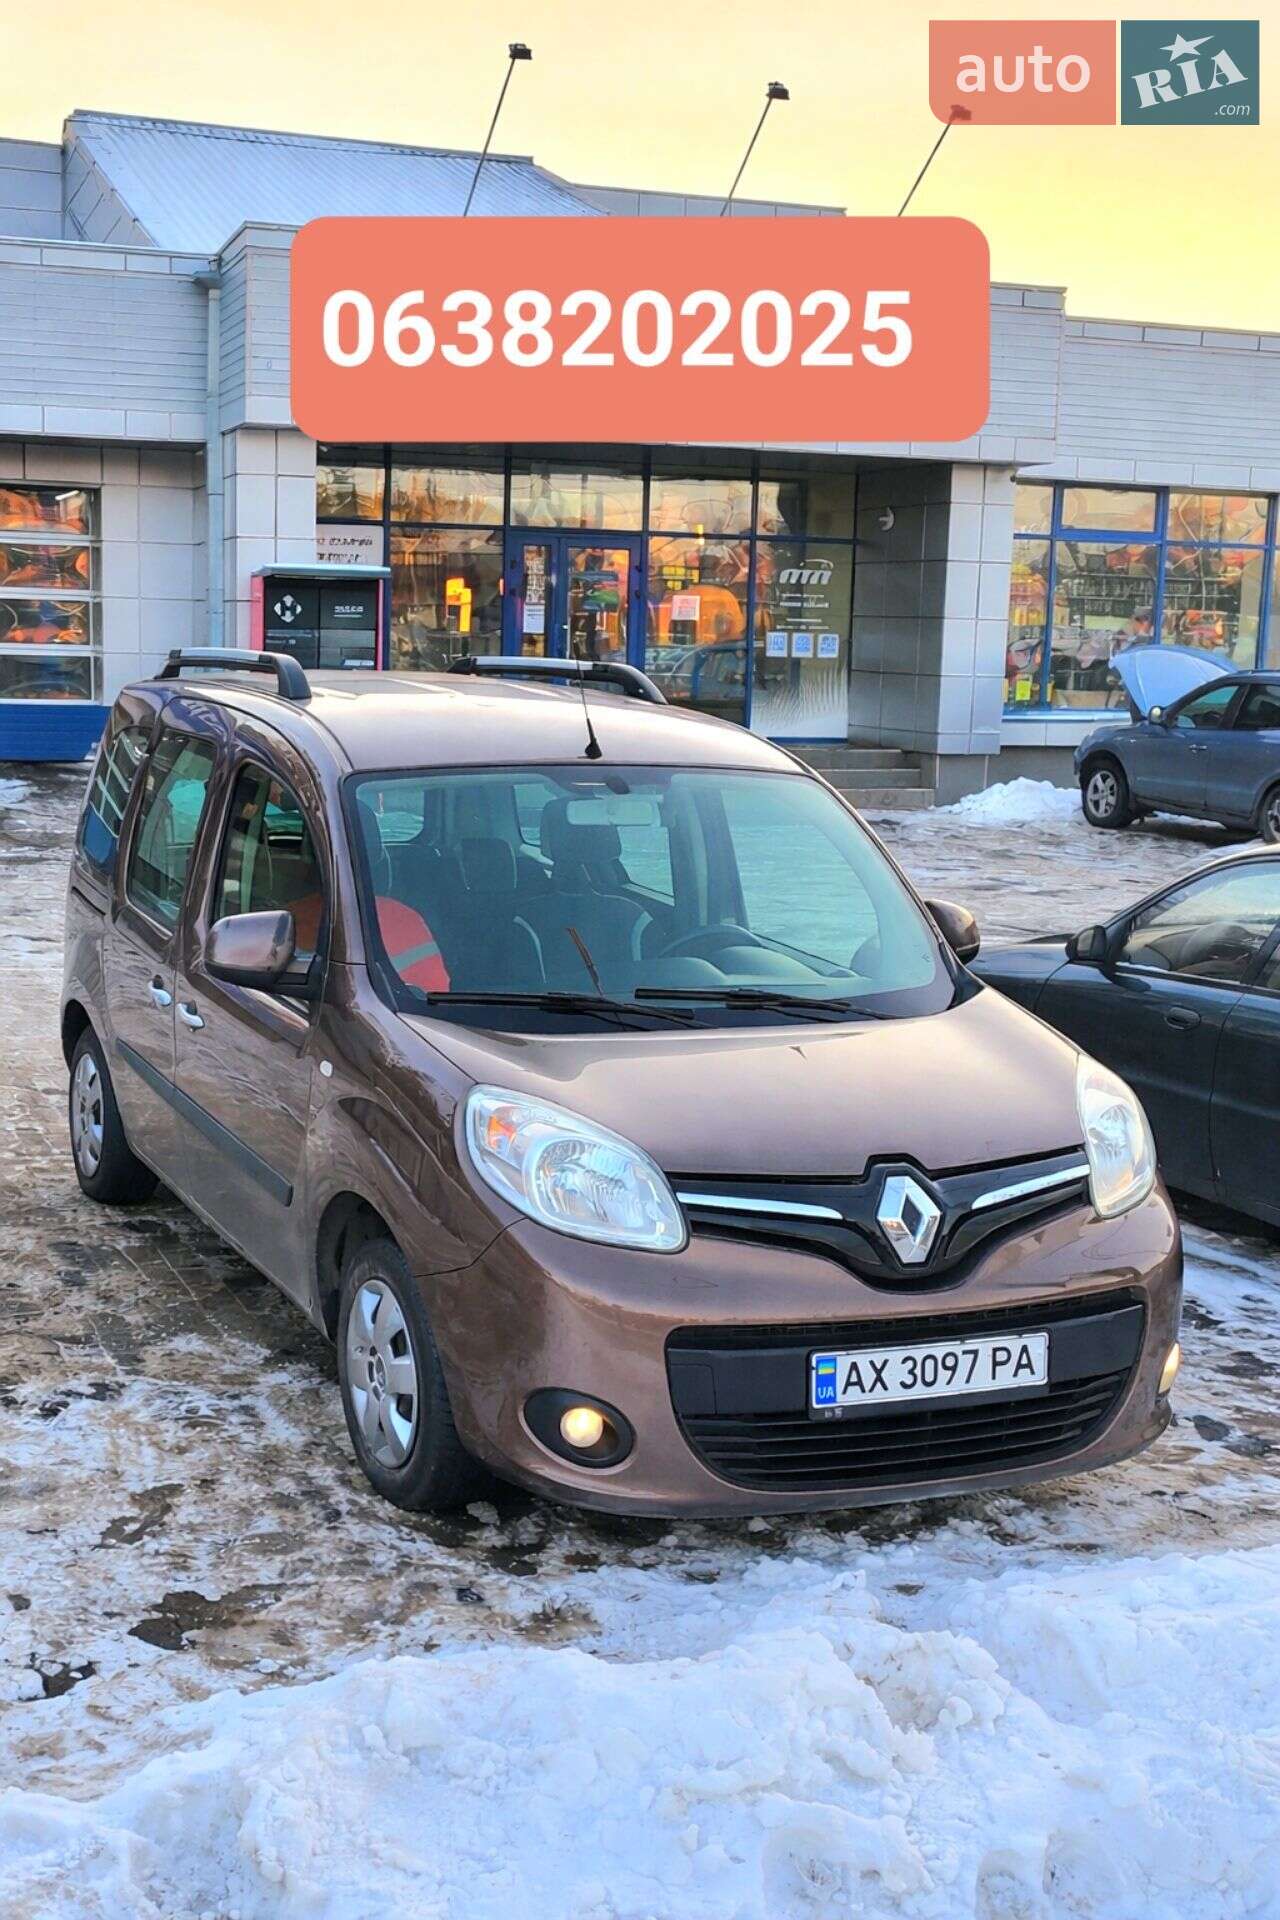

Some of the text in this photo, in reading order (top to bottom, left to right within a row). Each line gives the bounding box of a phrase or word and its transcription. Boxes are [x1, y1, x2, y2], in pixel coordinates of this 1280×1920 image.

[842, 1345, 1036, 1396] AX 3097 PA
[817, 1386, 835, 1400] UA
